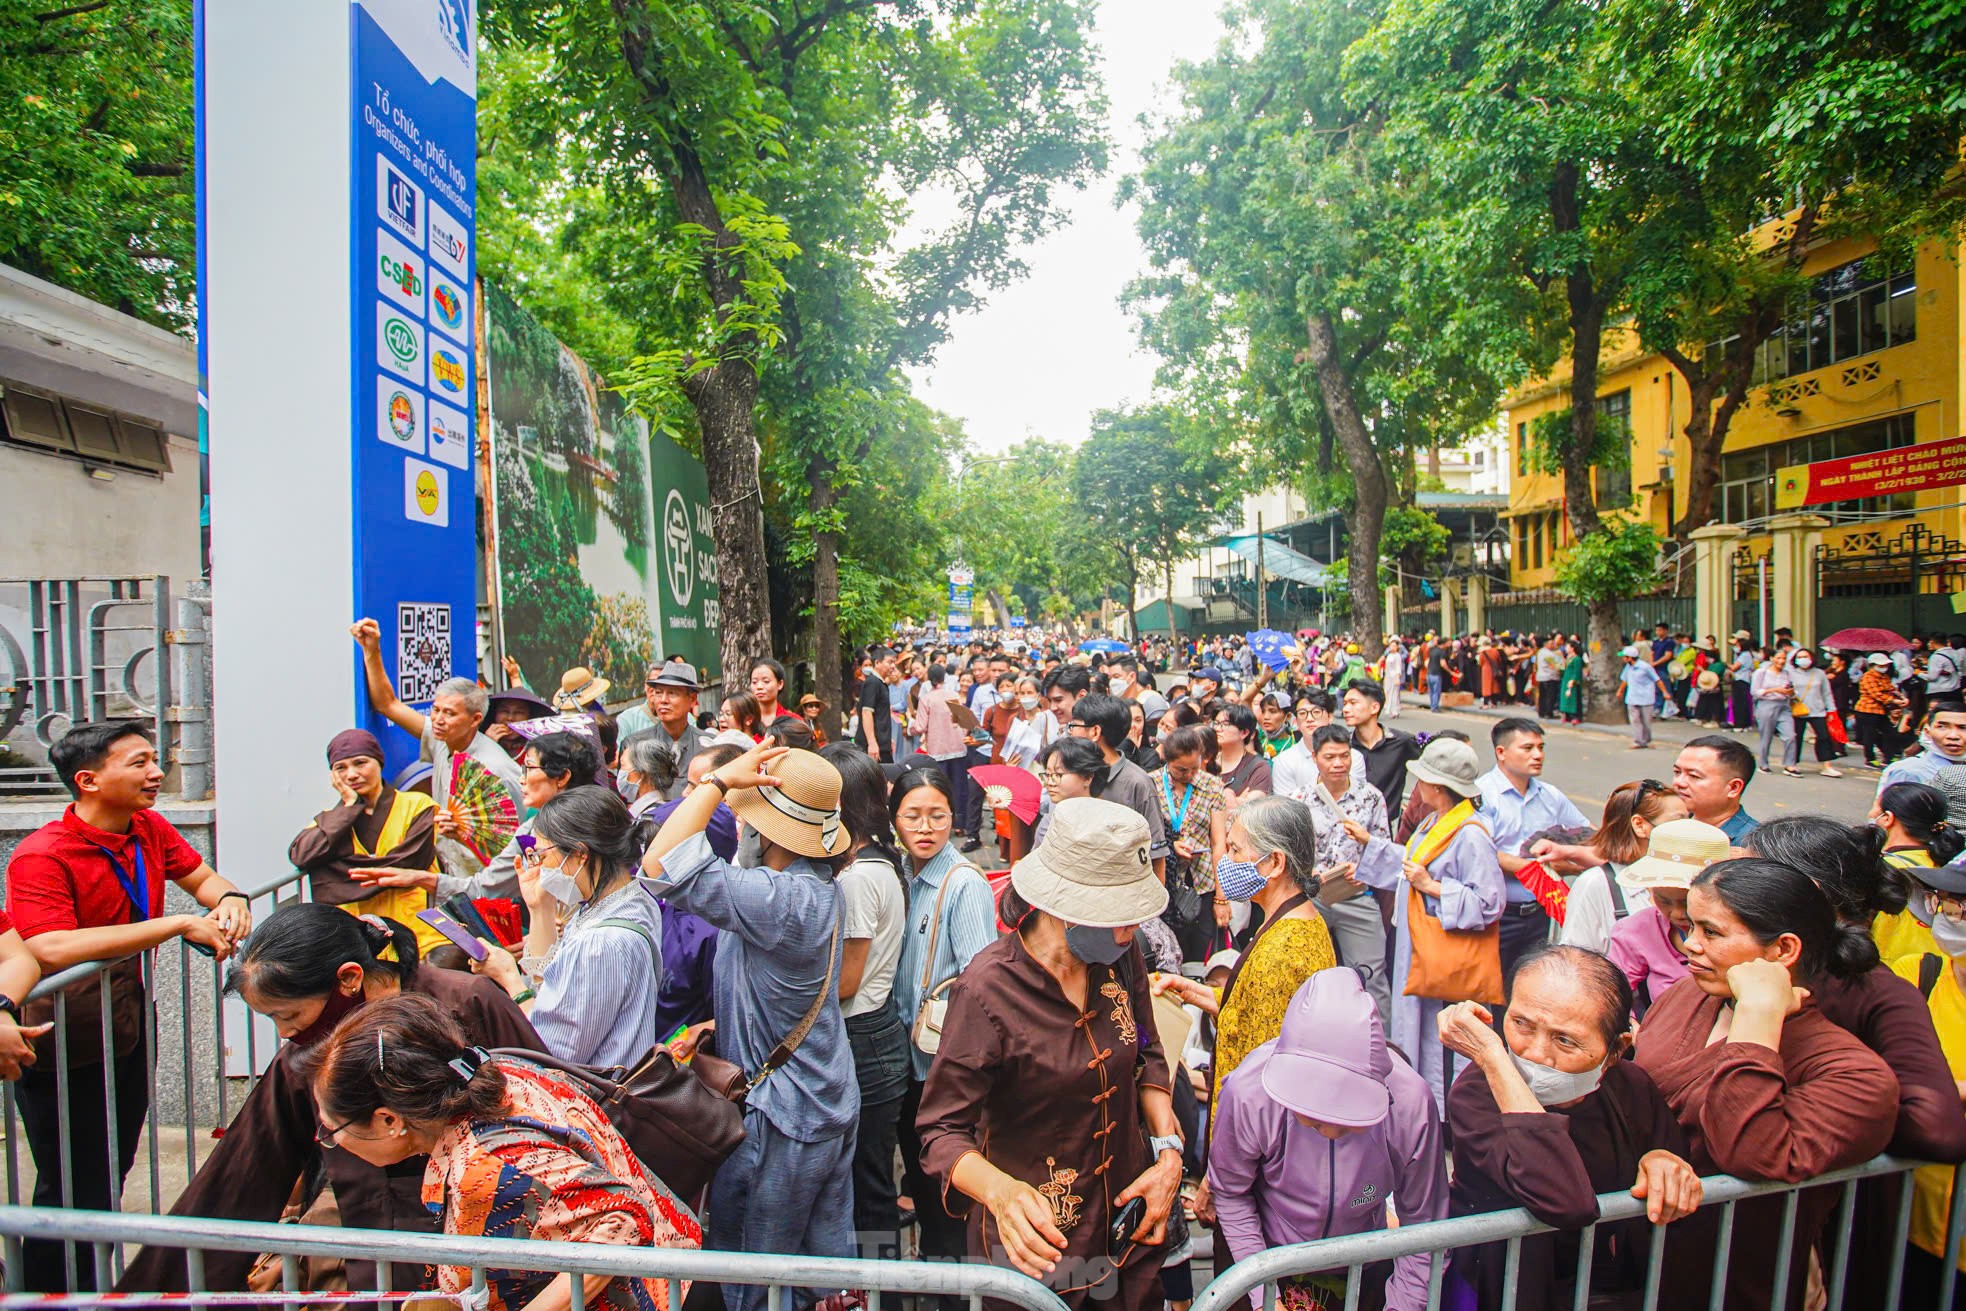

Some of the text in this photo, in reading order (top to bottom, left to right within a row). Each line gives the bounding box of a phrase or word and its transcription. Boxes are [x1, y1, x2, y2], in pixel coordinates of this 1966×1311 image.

[373, 81, 390, 115] Tổ
[426, 140, 447, 173] phối
[449, 159, 467, 193] hợp
[364, 104, 472, 219] Organizers and Coordinators
[388, 209, 416, 238] VIETFAIR
[381, 256, 421, 296] CSED
[1820, 475, 1847, 487] NGÀY
[1942, 456, 1966, 468] CỘN
[1850, 443, 1966, 470] NHIỆT LIỆT CHÀO MỪN
[1936, 469, 1966, 481] 3/2/2
[695, 502, 714, 539] XAN
[704, 598, 720, 637] ĐẸP
[1138, 847, 1148, 865] C
